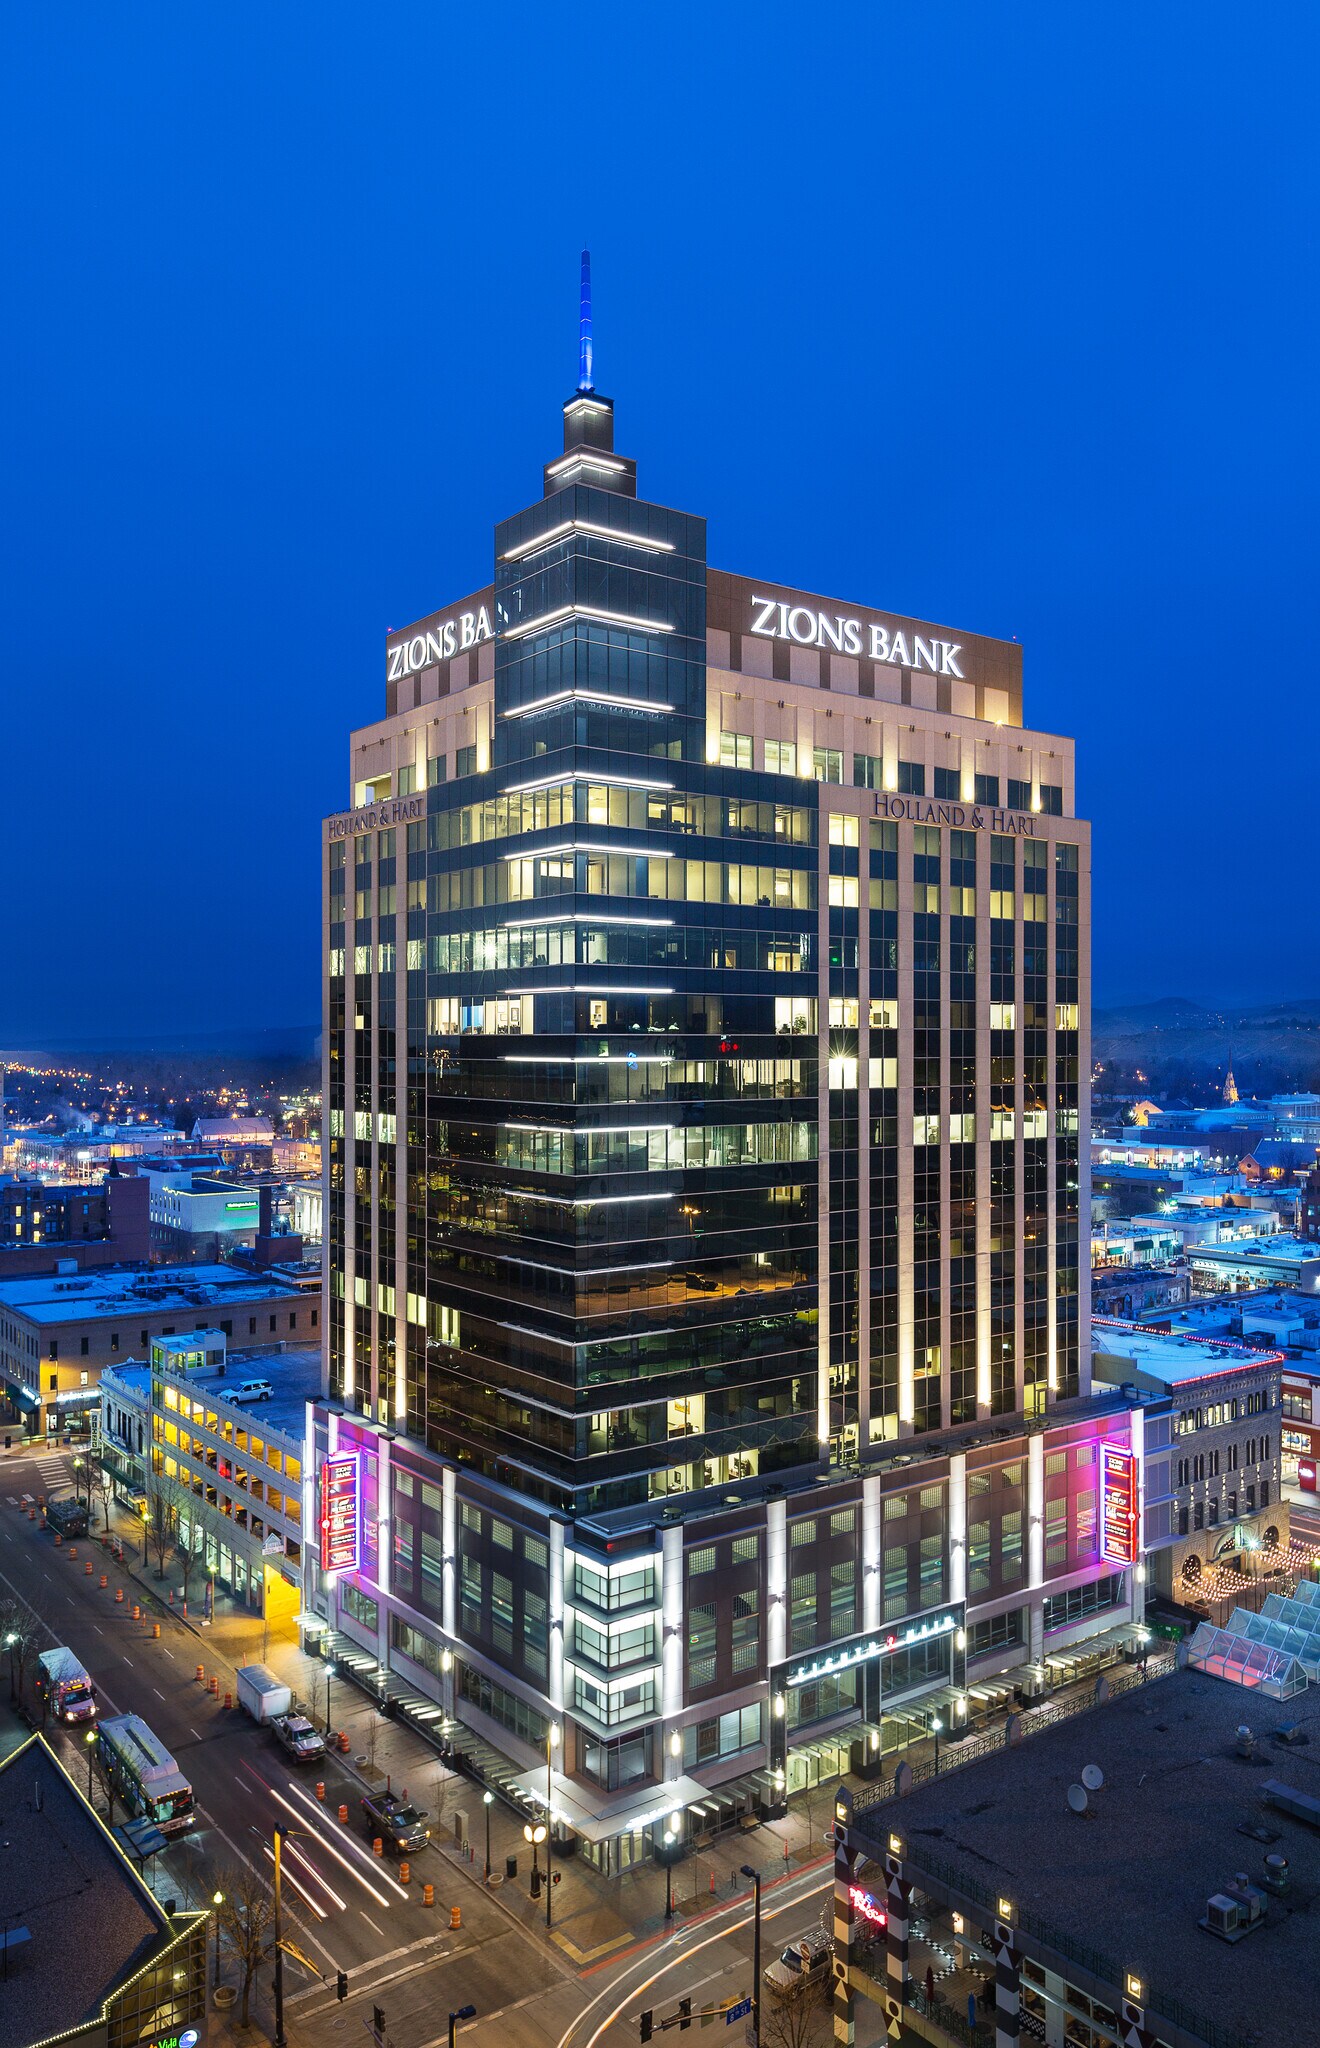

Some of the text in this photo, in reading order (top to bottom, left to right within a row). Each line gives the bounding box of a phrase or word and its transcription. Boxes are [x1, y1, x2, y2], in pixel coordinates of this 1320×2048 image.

[387, 600, 509, 682] ZIONS BA
[751, 594, 965, 679] ZIONS BANK
[328, 797, 423, 839] HOLLAND & HART
[873, 792, 1038, 836] HOLLAND & HART
